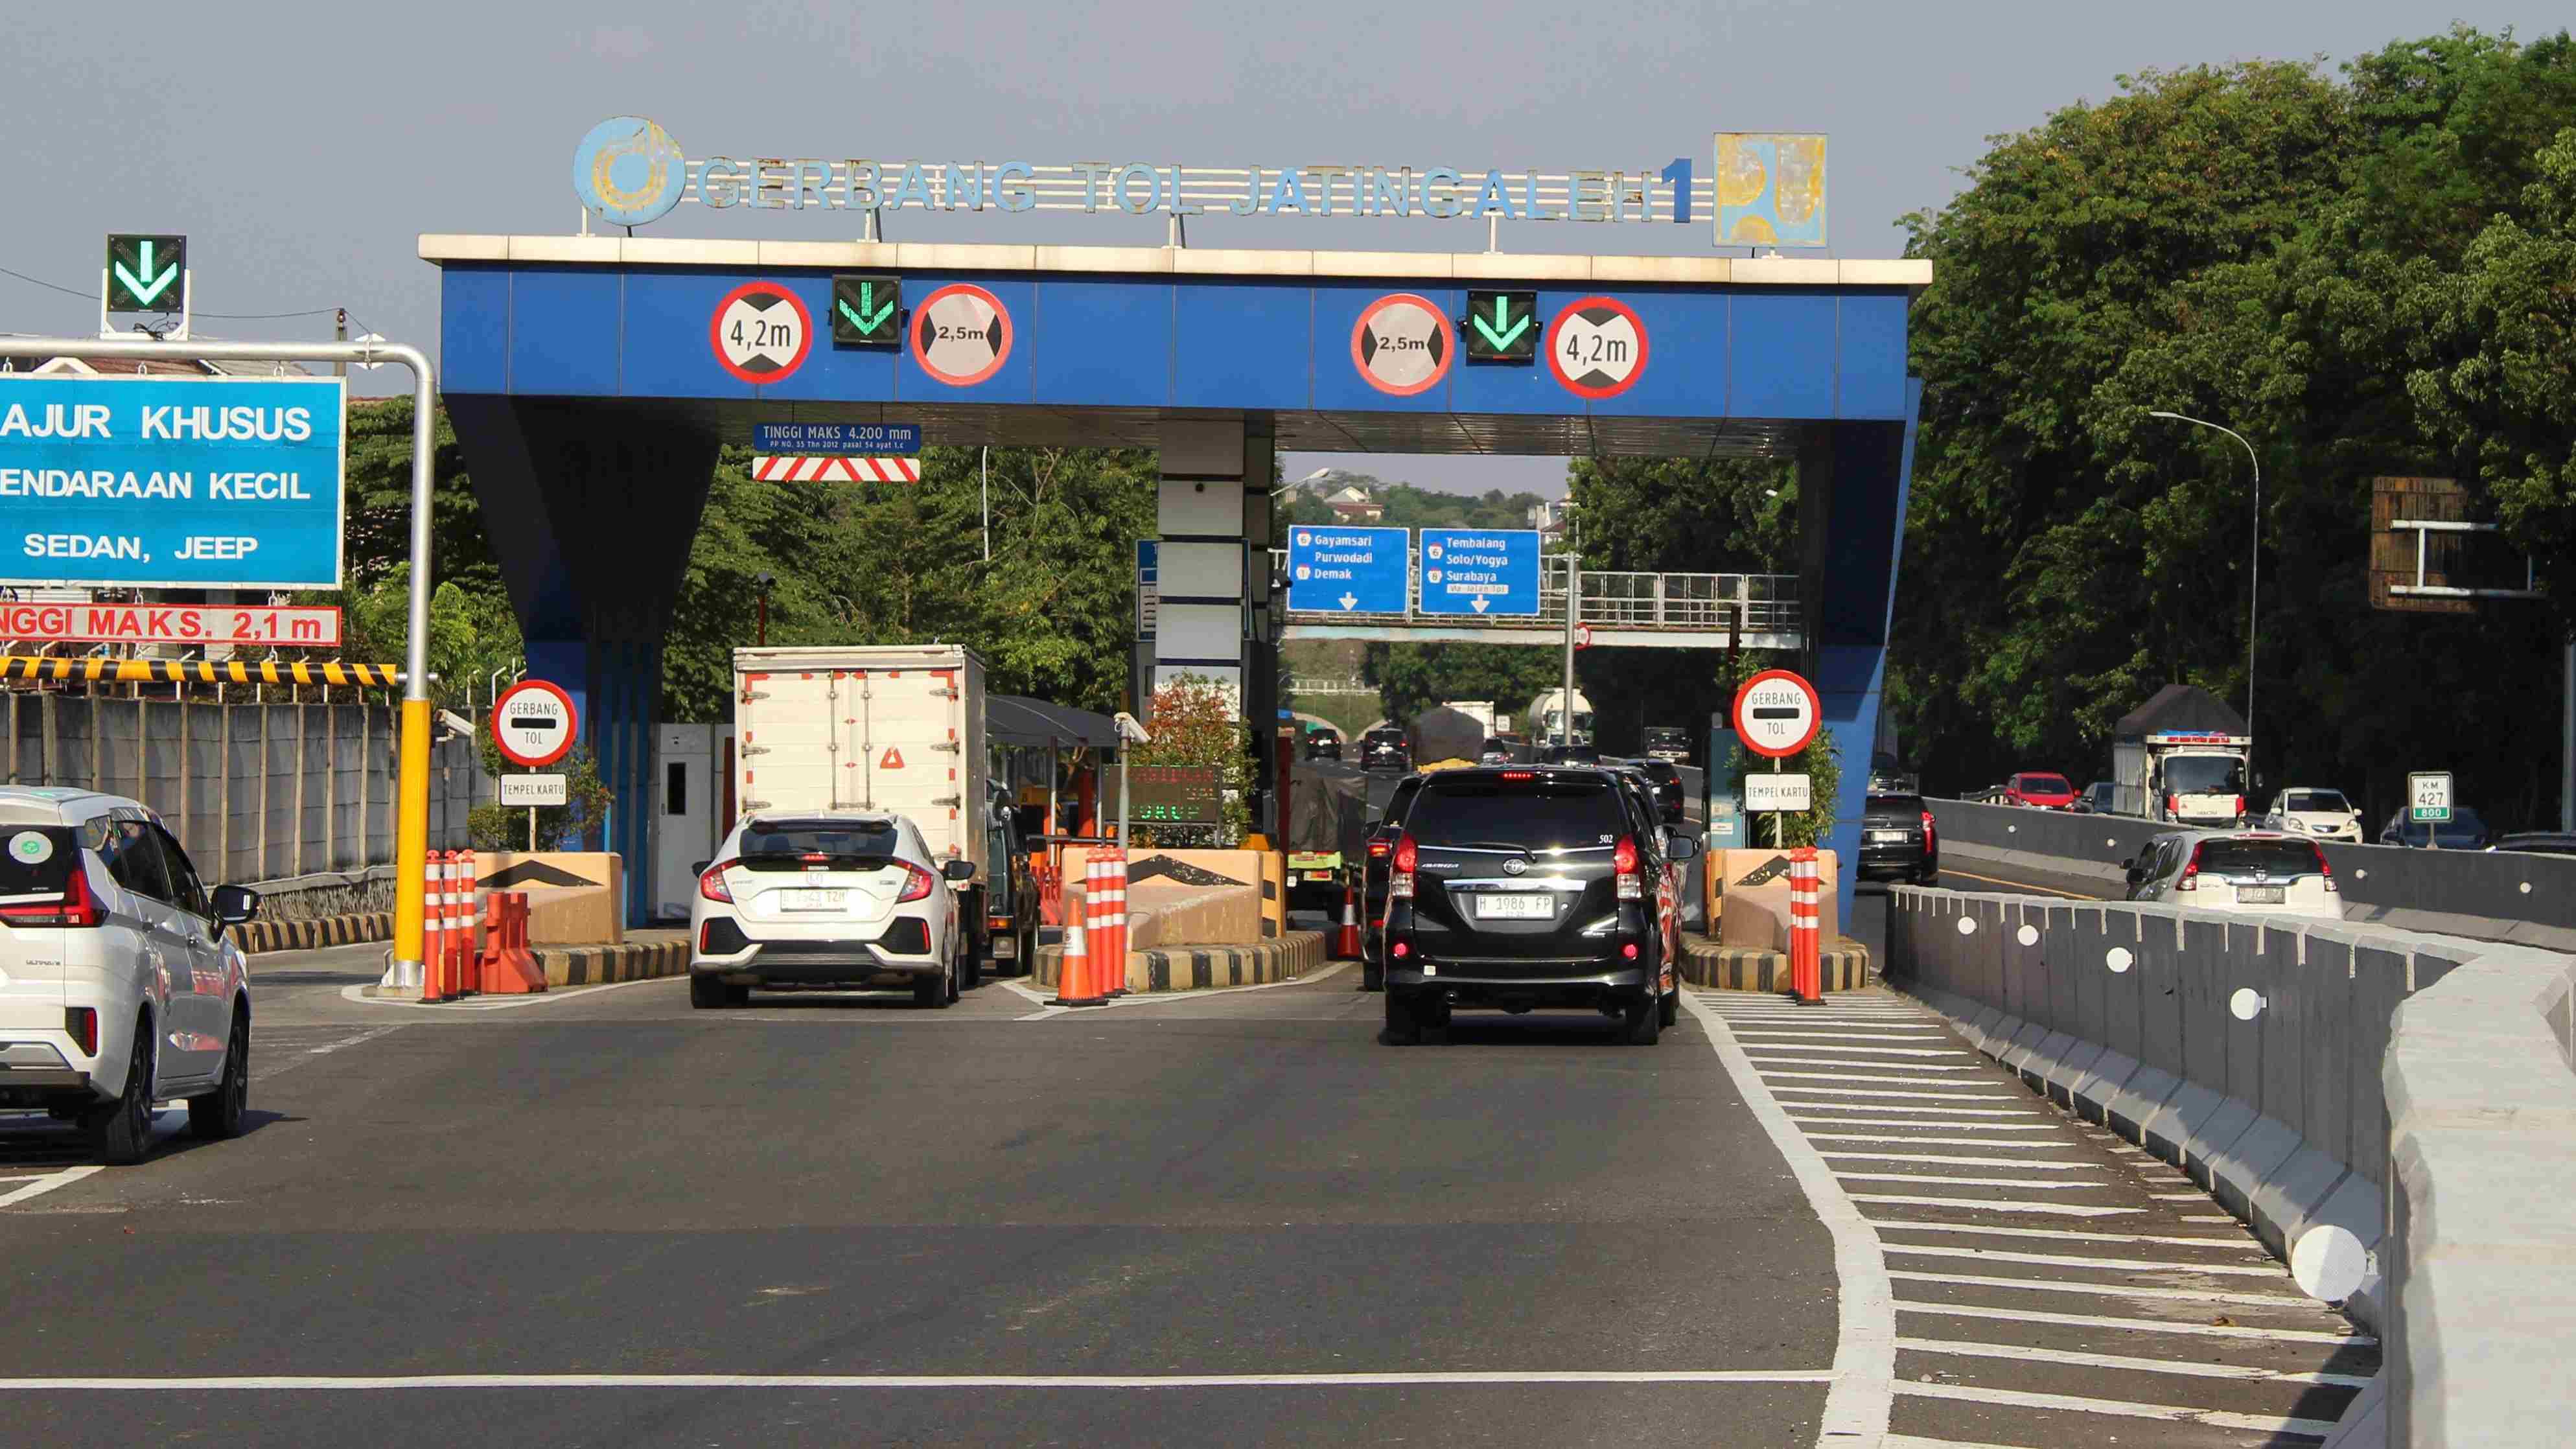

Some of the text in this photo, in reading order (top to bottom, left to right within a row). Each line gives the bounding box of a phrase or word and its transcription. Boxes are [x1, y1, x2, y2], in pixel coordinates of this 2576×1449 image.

[695, 156, 1693, 224] GERBANG TOL JATINGALEH 1
[730, 319, 791, 352] 4,2m
[938, 327, 984, 342] 2,5m
[1379, 336, 1426, 353] 2,5m
[1566, 334, 1627, 366] 4,2m
[0, 404, 311, 441] AJUR KHUSUS
[763, 426, 912, 441] TINGGI MAKS 4.200 mm
[0, 468, 311, 500] ENDARAAN KECIL
[1315, 535, 1372, 548] Gayamsari
[1446, 537, 1506, 551] Tembalang
[23, 534, 259, 564] SEDAN, JEEP
[1315, 551, 1373, 563] Purwodadi
[1446, 555, 1508, 568] Solo/Yogya
[1314, 568, 1352, 579] Demak
[1446, 570, 1497, 584] Surabaya
[88, 609, 213, 637] MAKS.
[1751, 692, 1801, 706] GERBANG
[509, 702, 559, 715] GERBANG
[1767, 722, 1786, 735] TOL
[524, 731, 543, 745] TOL
[503, 783, 564, 795] TEMPEL KARTU
[1748, 787, 1809, 798] TEMPEL KARTU
[2419, 792, 2443, 806] 427
[2421, 808, 2442, 817] 800
[1496, 897, 1525, 910] 1986
[1536, 897, 1551, 910] FP
